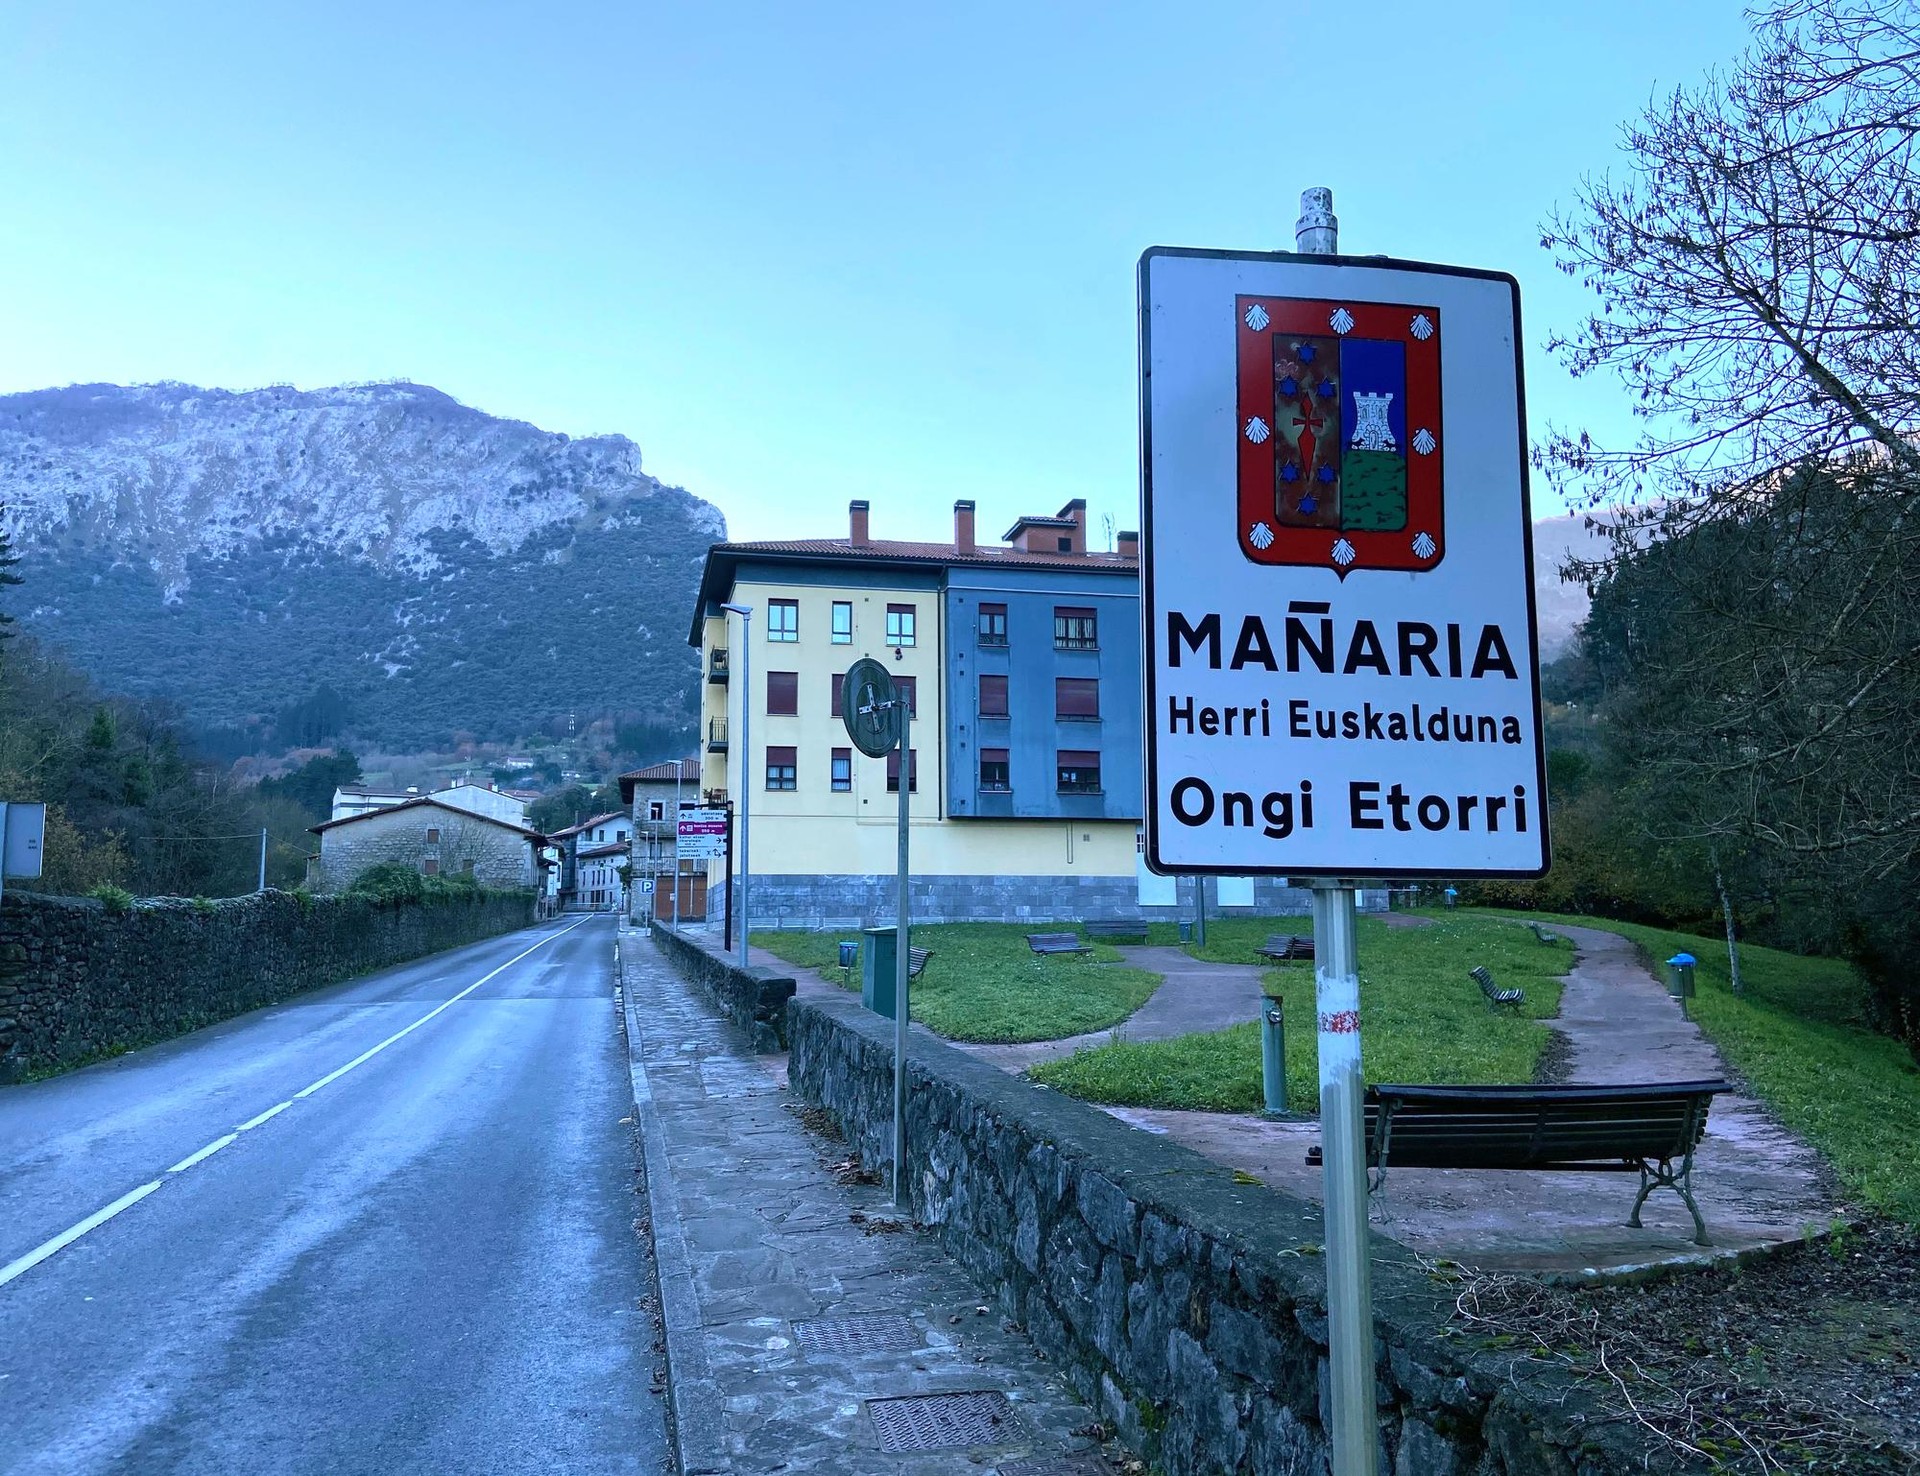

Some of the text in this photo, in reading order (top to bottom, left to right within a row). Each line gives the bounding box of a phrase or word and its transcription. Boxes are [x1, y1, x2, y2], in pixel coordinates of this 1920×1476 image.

[1167, 600, 1520, 680] MAÑARIA
[1168, 695, 1523, 745] Herri Euskalduna
[1170, 776, 1527, 840] Ongi Etorri
